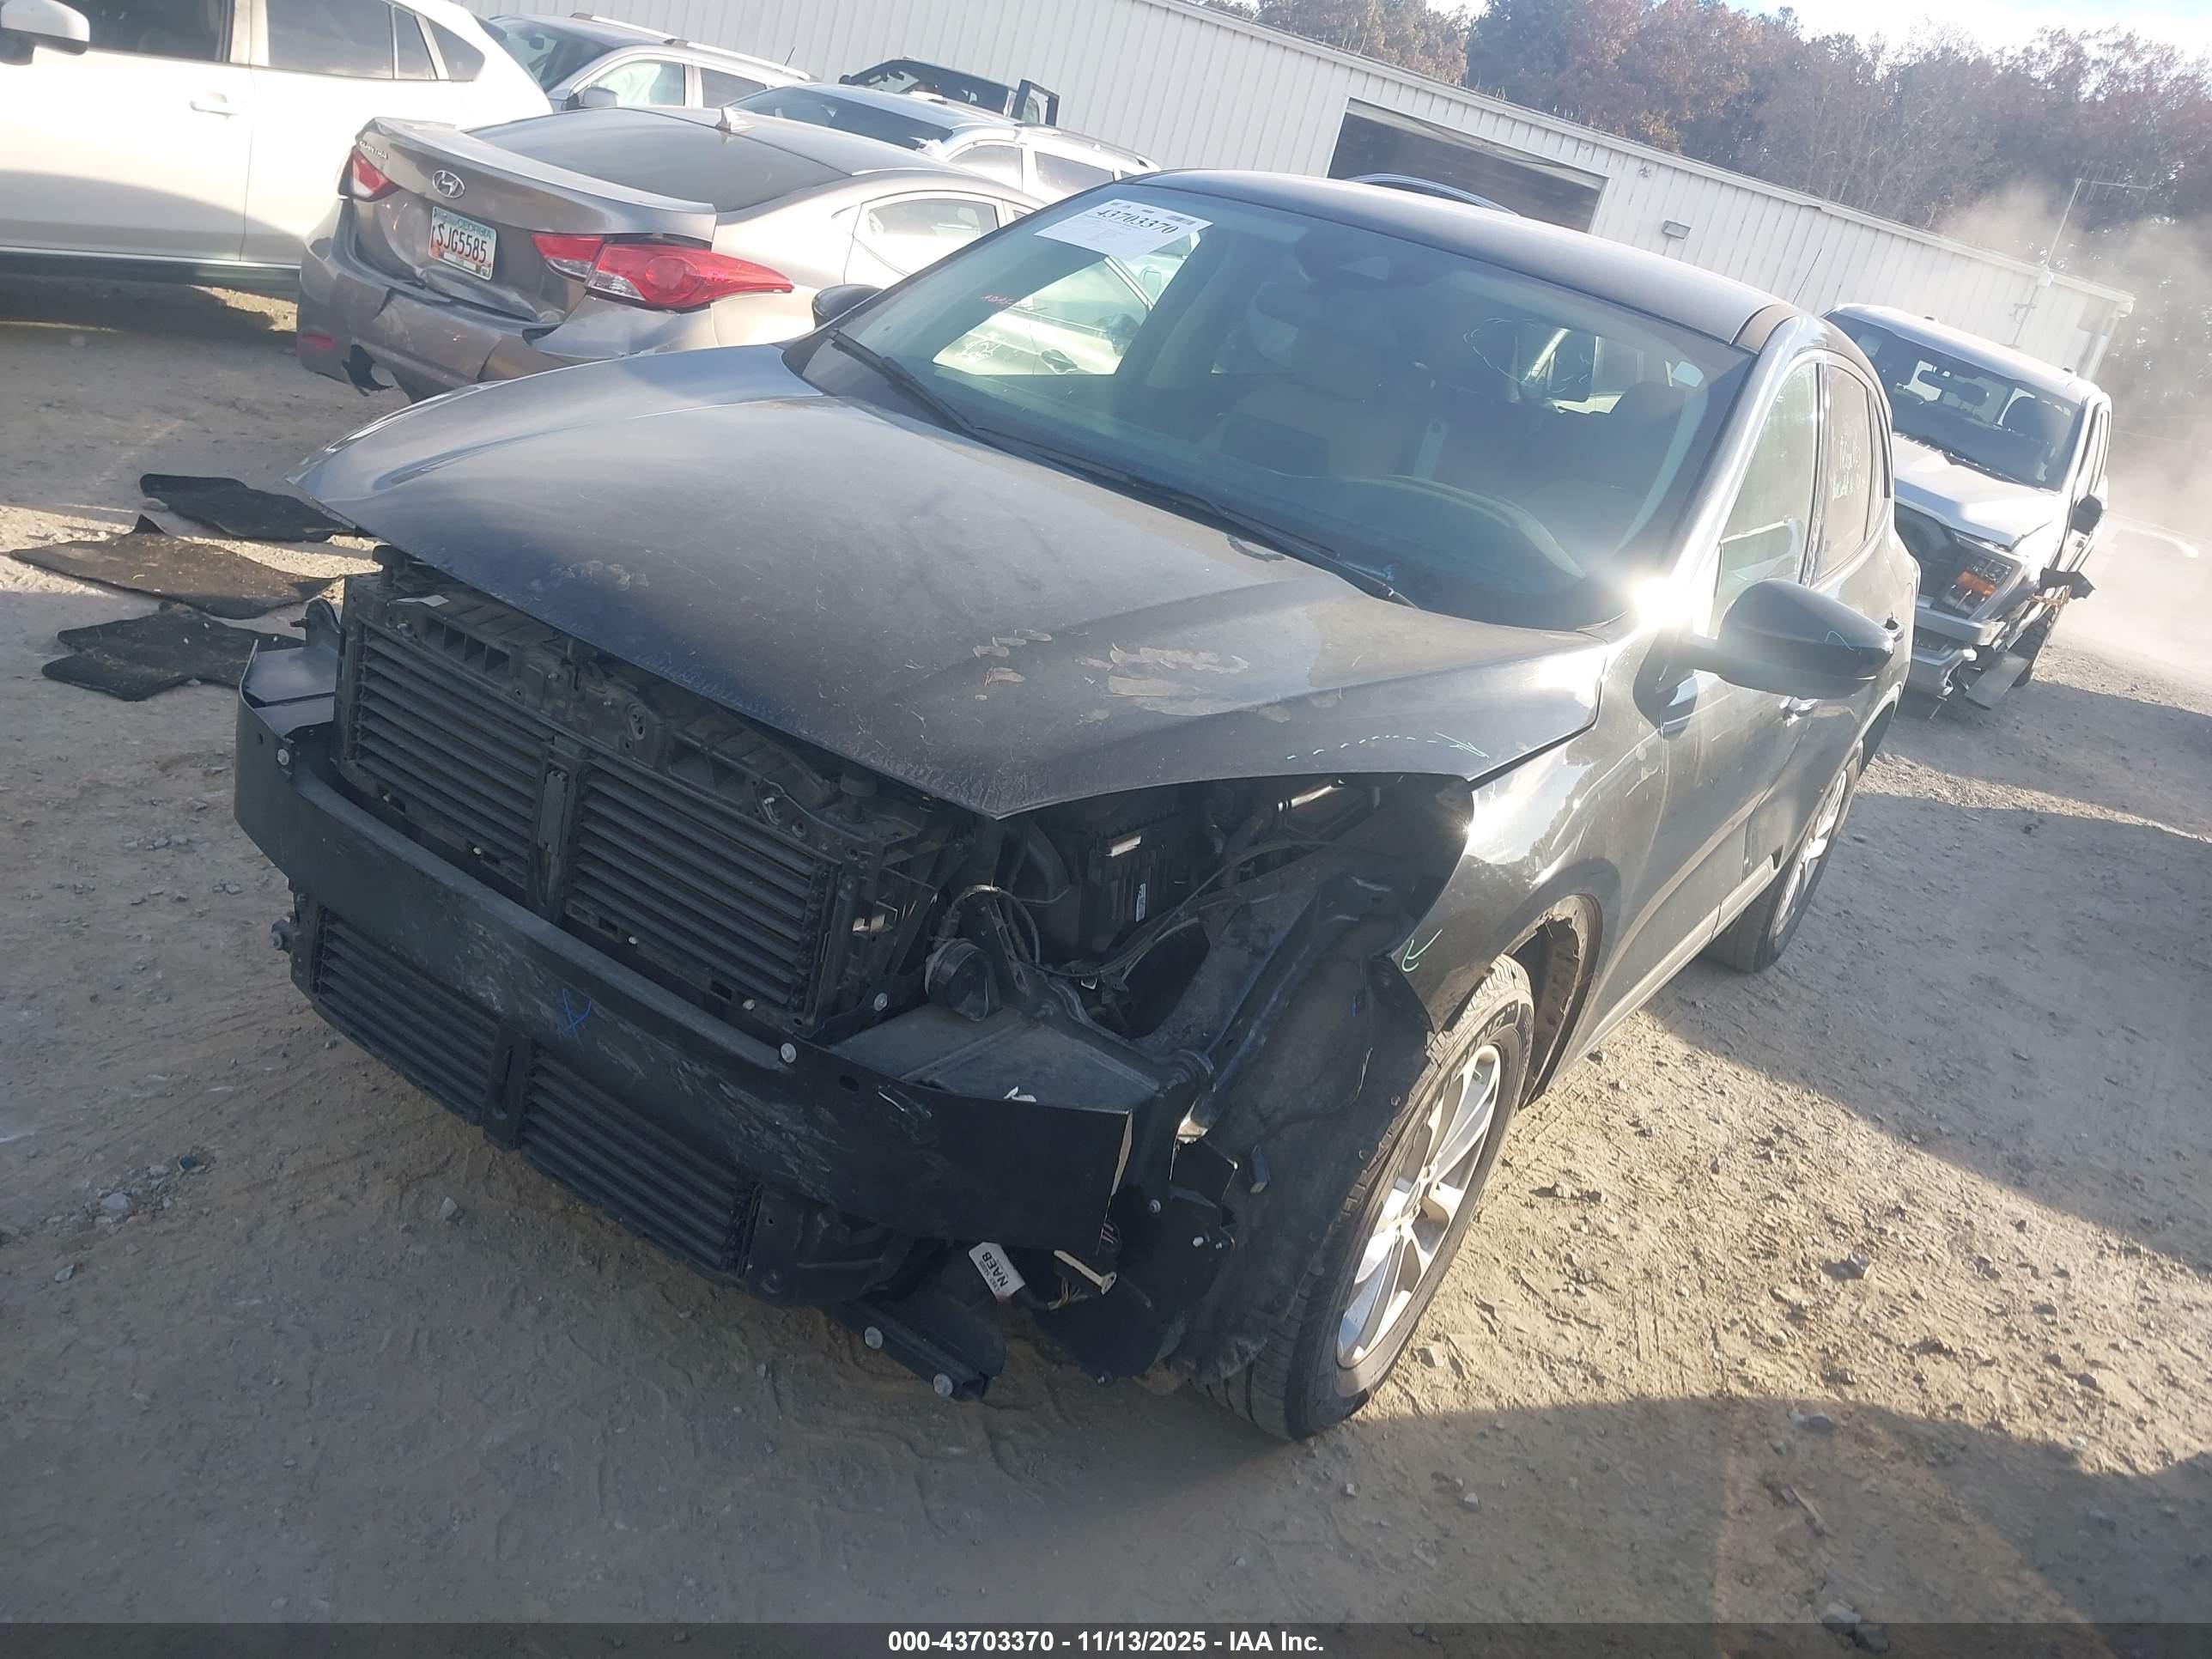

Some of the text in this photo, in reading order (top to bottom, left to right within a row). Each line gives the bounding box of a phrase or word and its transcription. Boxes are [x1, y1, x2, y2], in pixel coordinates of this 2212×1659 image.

[458, 219, 491, 240] GEORGIA
[1097, 210, 1180, 234] 43703370
[437, 222, 487, 264] SJG5585
[981, 1251, 1009, 1287] NAEB
